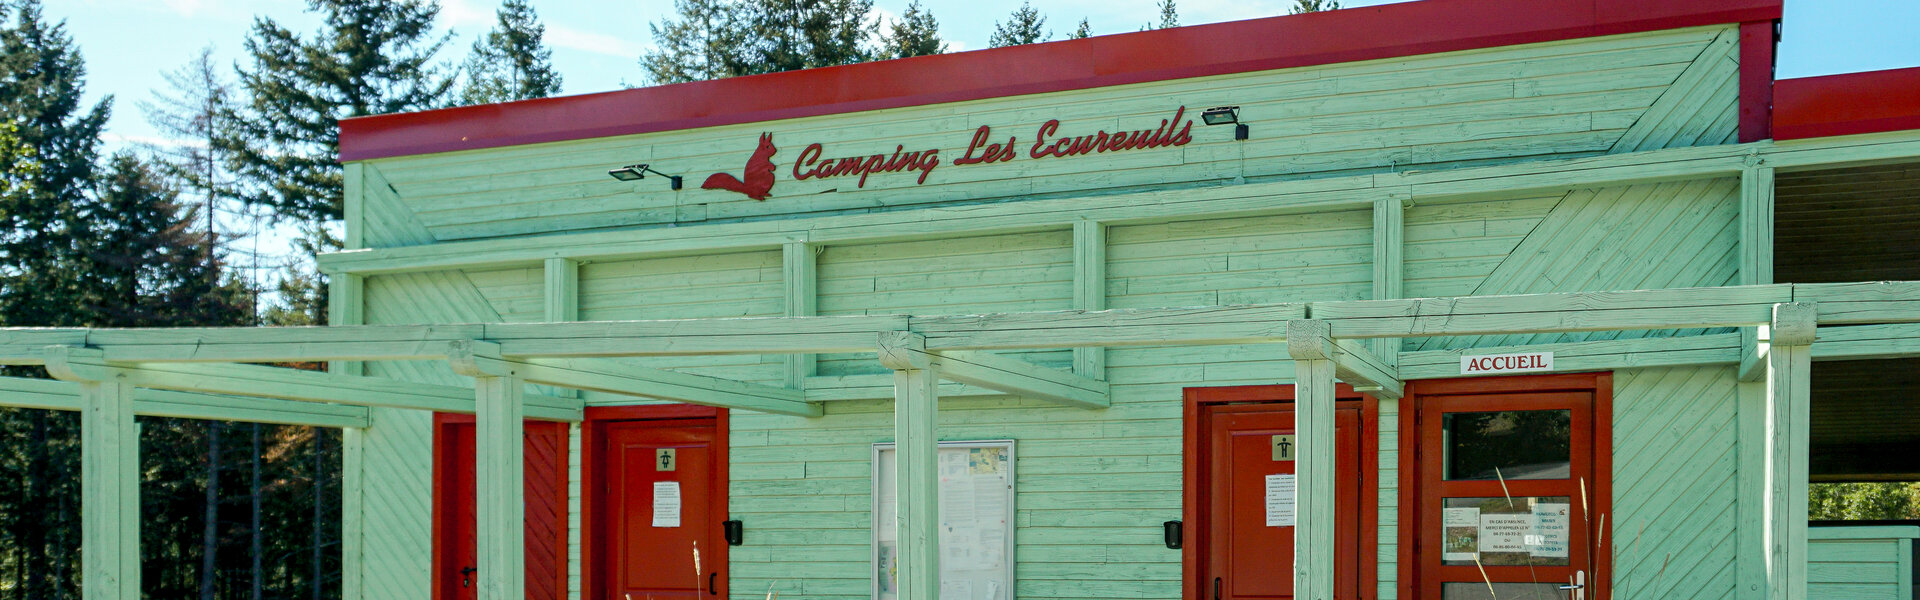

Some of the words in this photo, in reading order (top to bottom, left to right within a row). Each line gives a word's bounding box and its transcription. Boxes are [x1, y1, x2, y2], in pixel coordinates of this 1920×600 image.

[793, 142, 940, 188] Camping
[953, 125, 1017, 166] Les
[1030, 105, 1193, 159] Ecureuils
[1467, 354, 1548, 372] ACCUEIL
